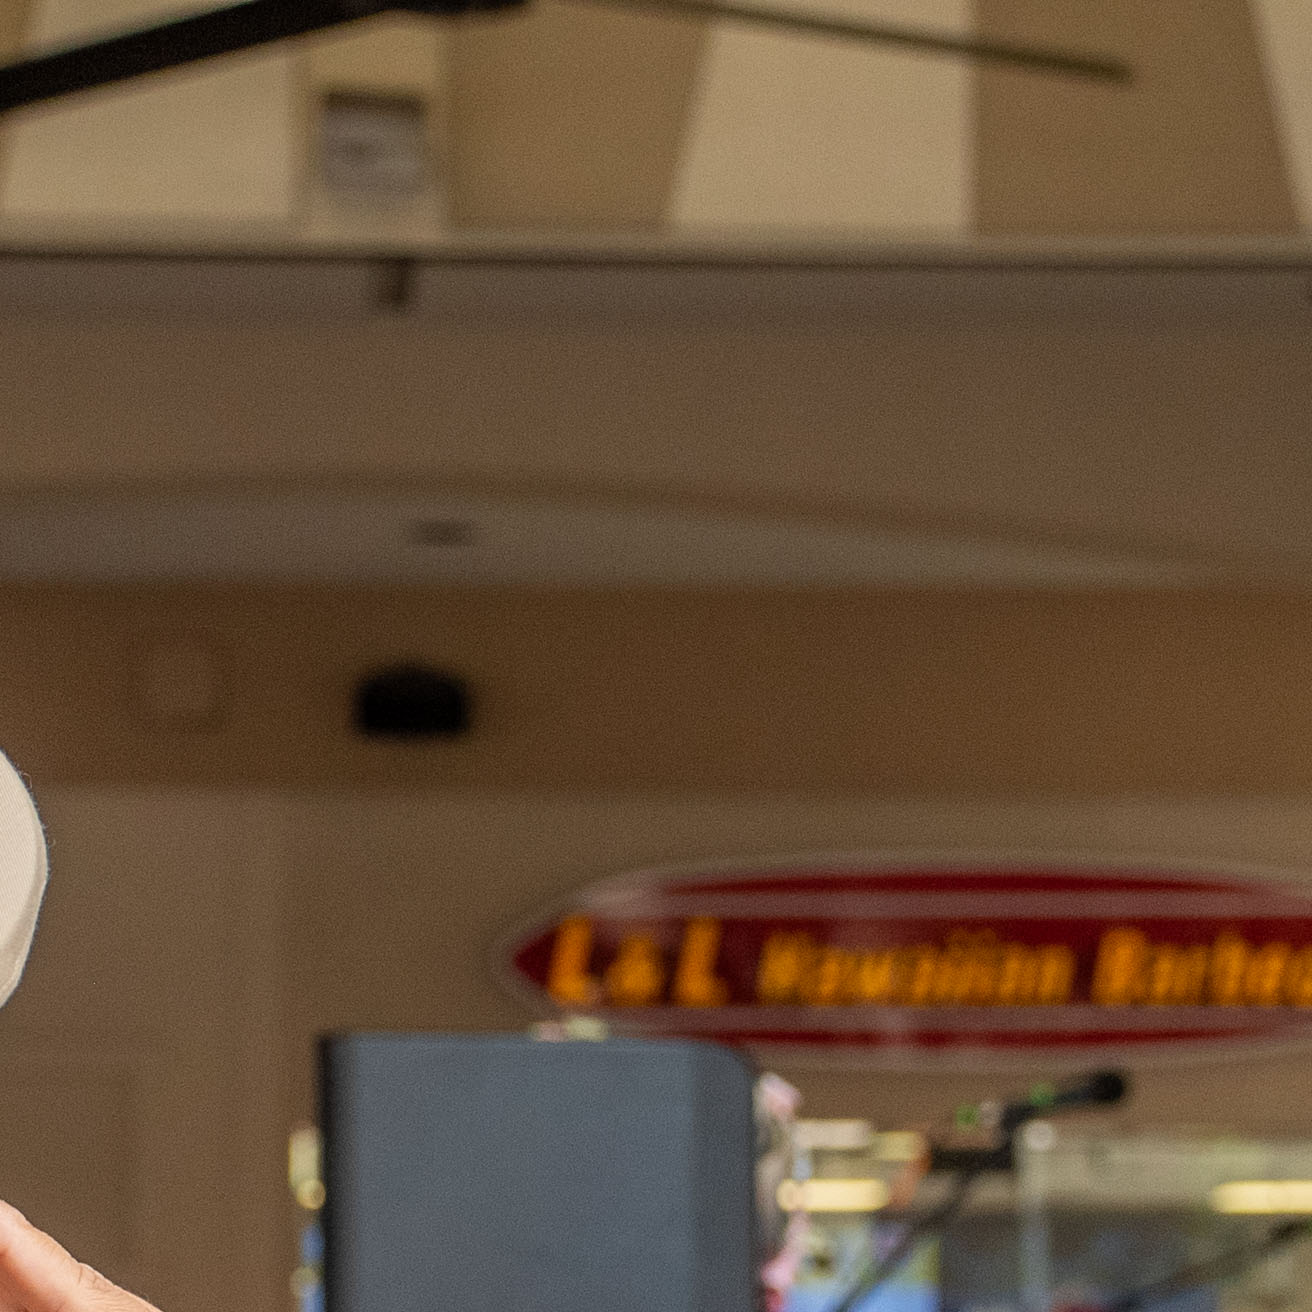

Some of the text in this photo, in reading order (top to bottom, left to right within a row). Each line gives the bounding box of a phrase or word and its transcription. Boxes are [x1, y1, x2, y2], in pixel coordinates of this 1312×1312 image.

[549, 915, 598, 1006] L
[604, 932, 666, 1004] &
[673, 915, 730, 1007] L
